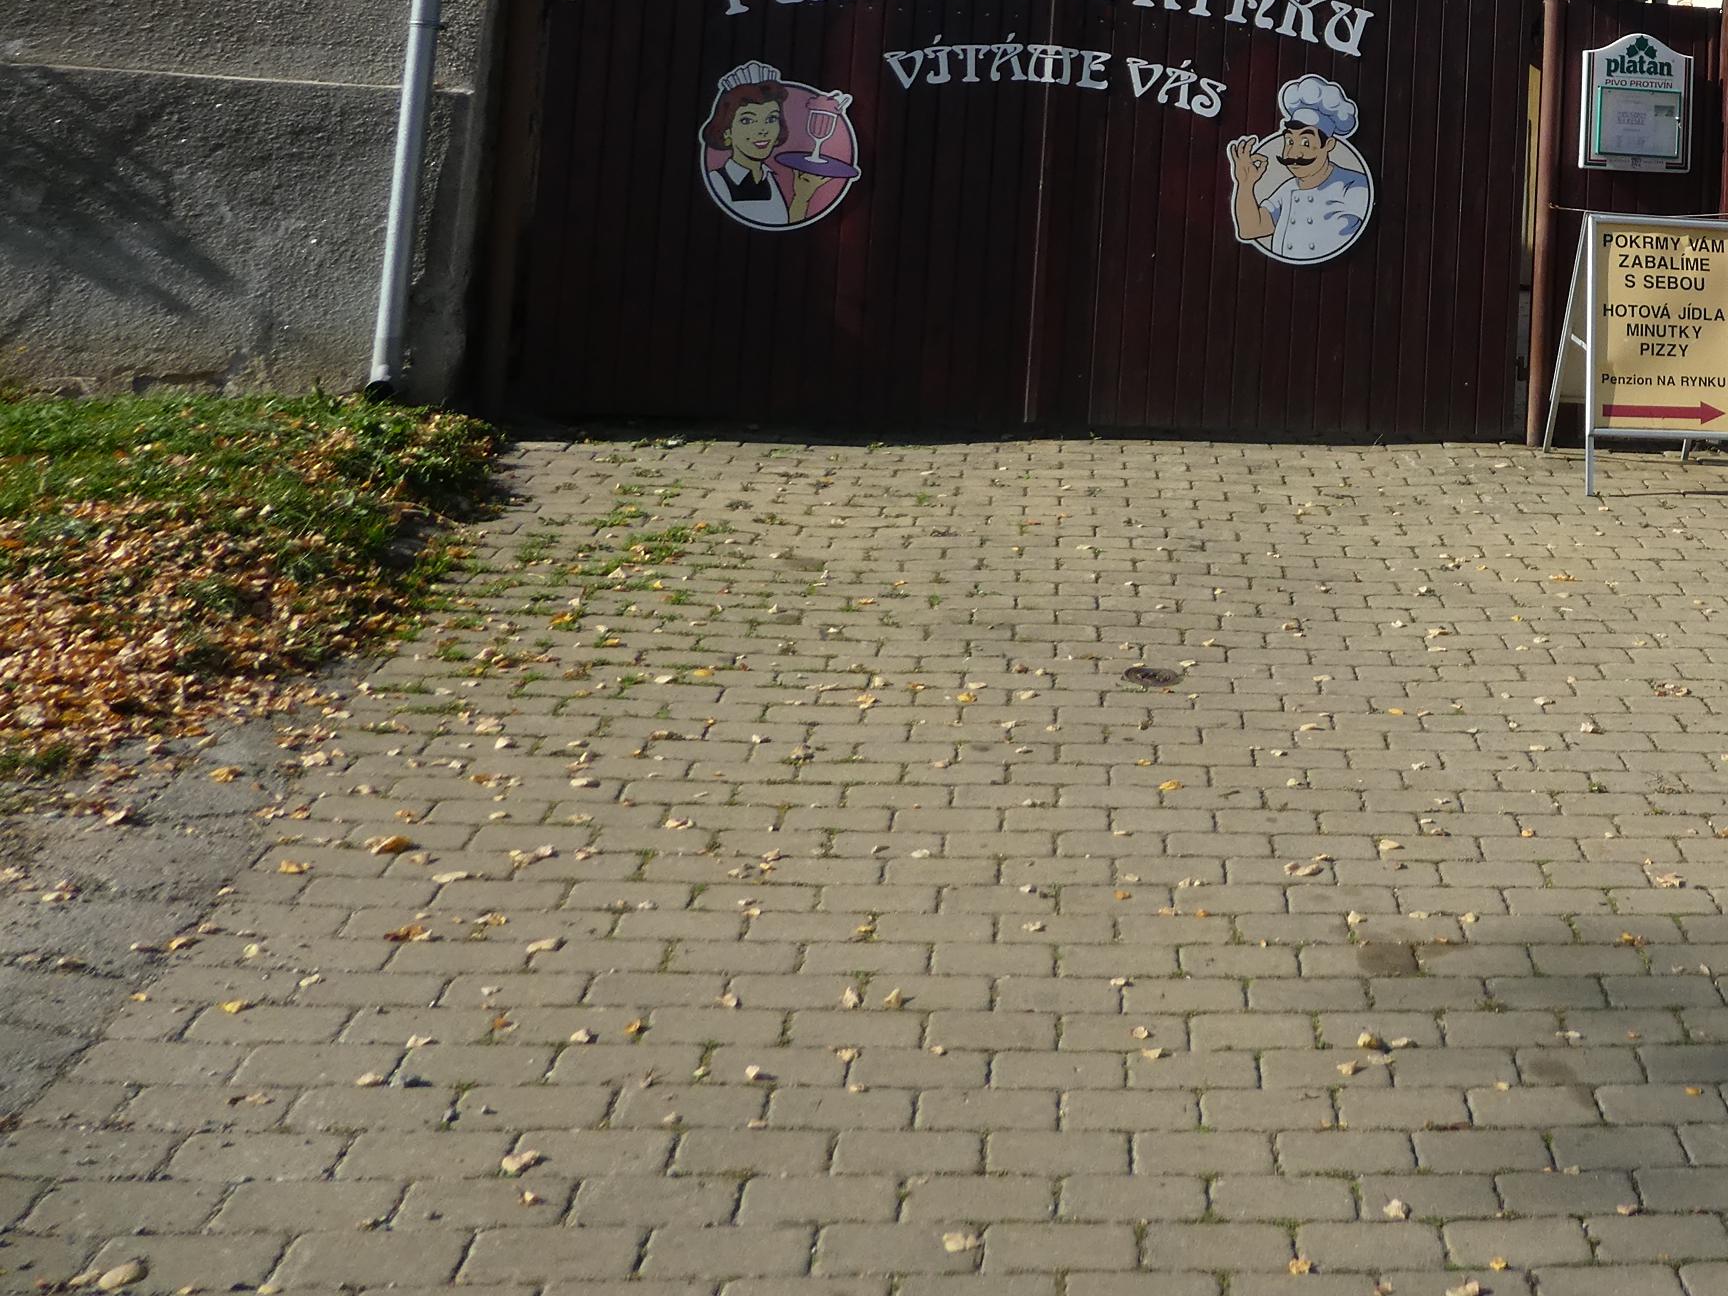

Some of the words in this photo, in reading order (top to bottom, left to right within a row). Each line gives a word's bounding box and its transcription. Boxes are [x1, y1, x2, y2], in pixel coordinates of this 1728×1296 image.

[1606, 55, 1674, 77] platan
[884, 32, 1112, 90] VÍTÁME
[1126, 59, 1227, 119] VÁS
[1605, 79, 1628, 87] PIVO
[1630, 78, 1673, 89] PROTIVÍN
[1603, 233, 1681, 251] POKRMY
[1689, 236, 1725, 253] VÁM
[1618, 253, 1710, 272] ZABALÍME
[1624, 275, 1636, 289] S
[1643, 276, 1706, 291] SEBOU
[1603, 301, 1671, 320] HOTOVÁ
[1678, 303, 1726, 322] JÍDLA
[1626, 323, 1702, 340] MINUTKY
[1640, 343, 1688, 357] PIZZY
[1601, 373, 1653, 387] Penzion
[1657, 375, 1676, 386] NA
[1680, 376, 1727, 388] RYNKU
